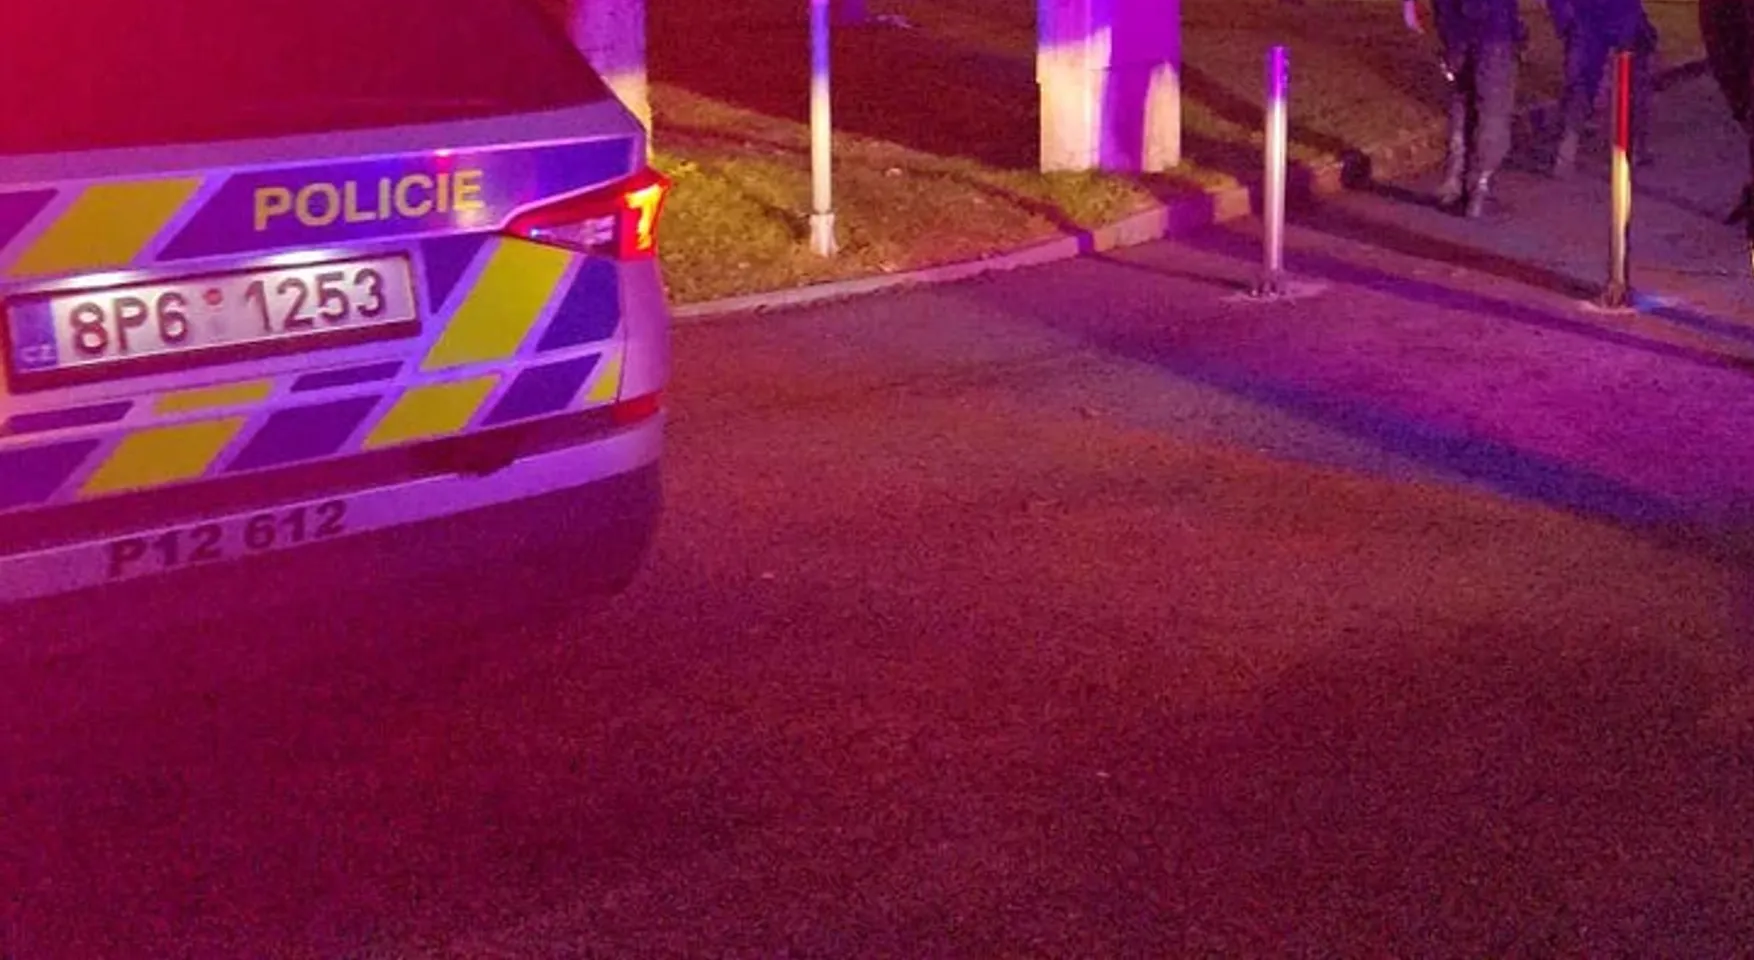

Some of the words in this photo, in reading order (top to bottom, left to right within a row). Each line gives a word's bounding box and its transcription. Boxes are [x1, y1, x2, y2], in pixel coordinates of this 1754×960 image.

[253, 170, 485, 230] POLICIE
[69, 289, 190, 357] 8P6
[244, 268, 387, 334] 1253
[107, 524, 224, 578] P12
[243, 499, 348, 550] 612
